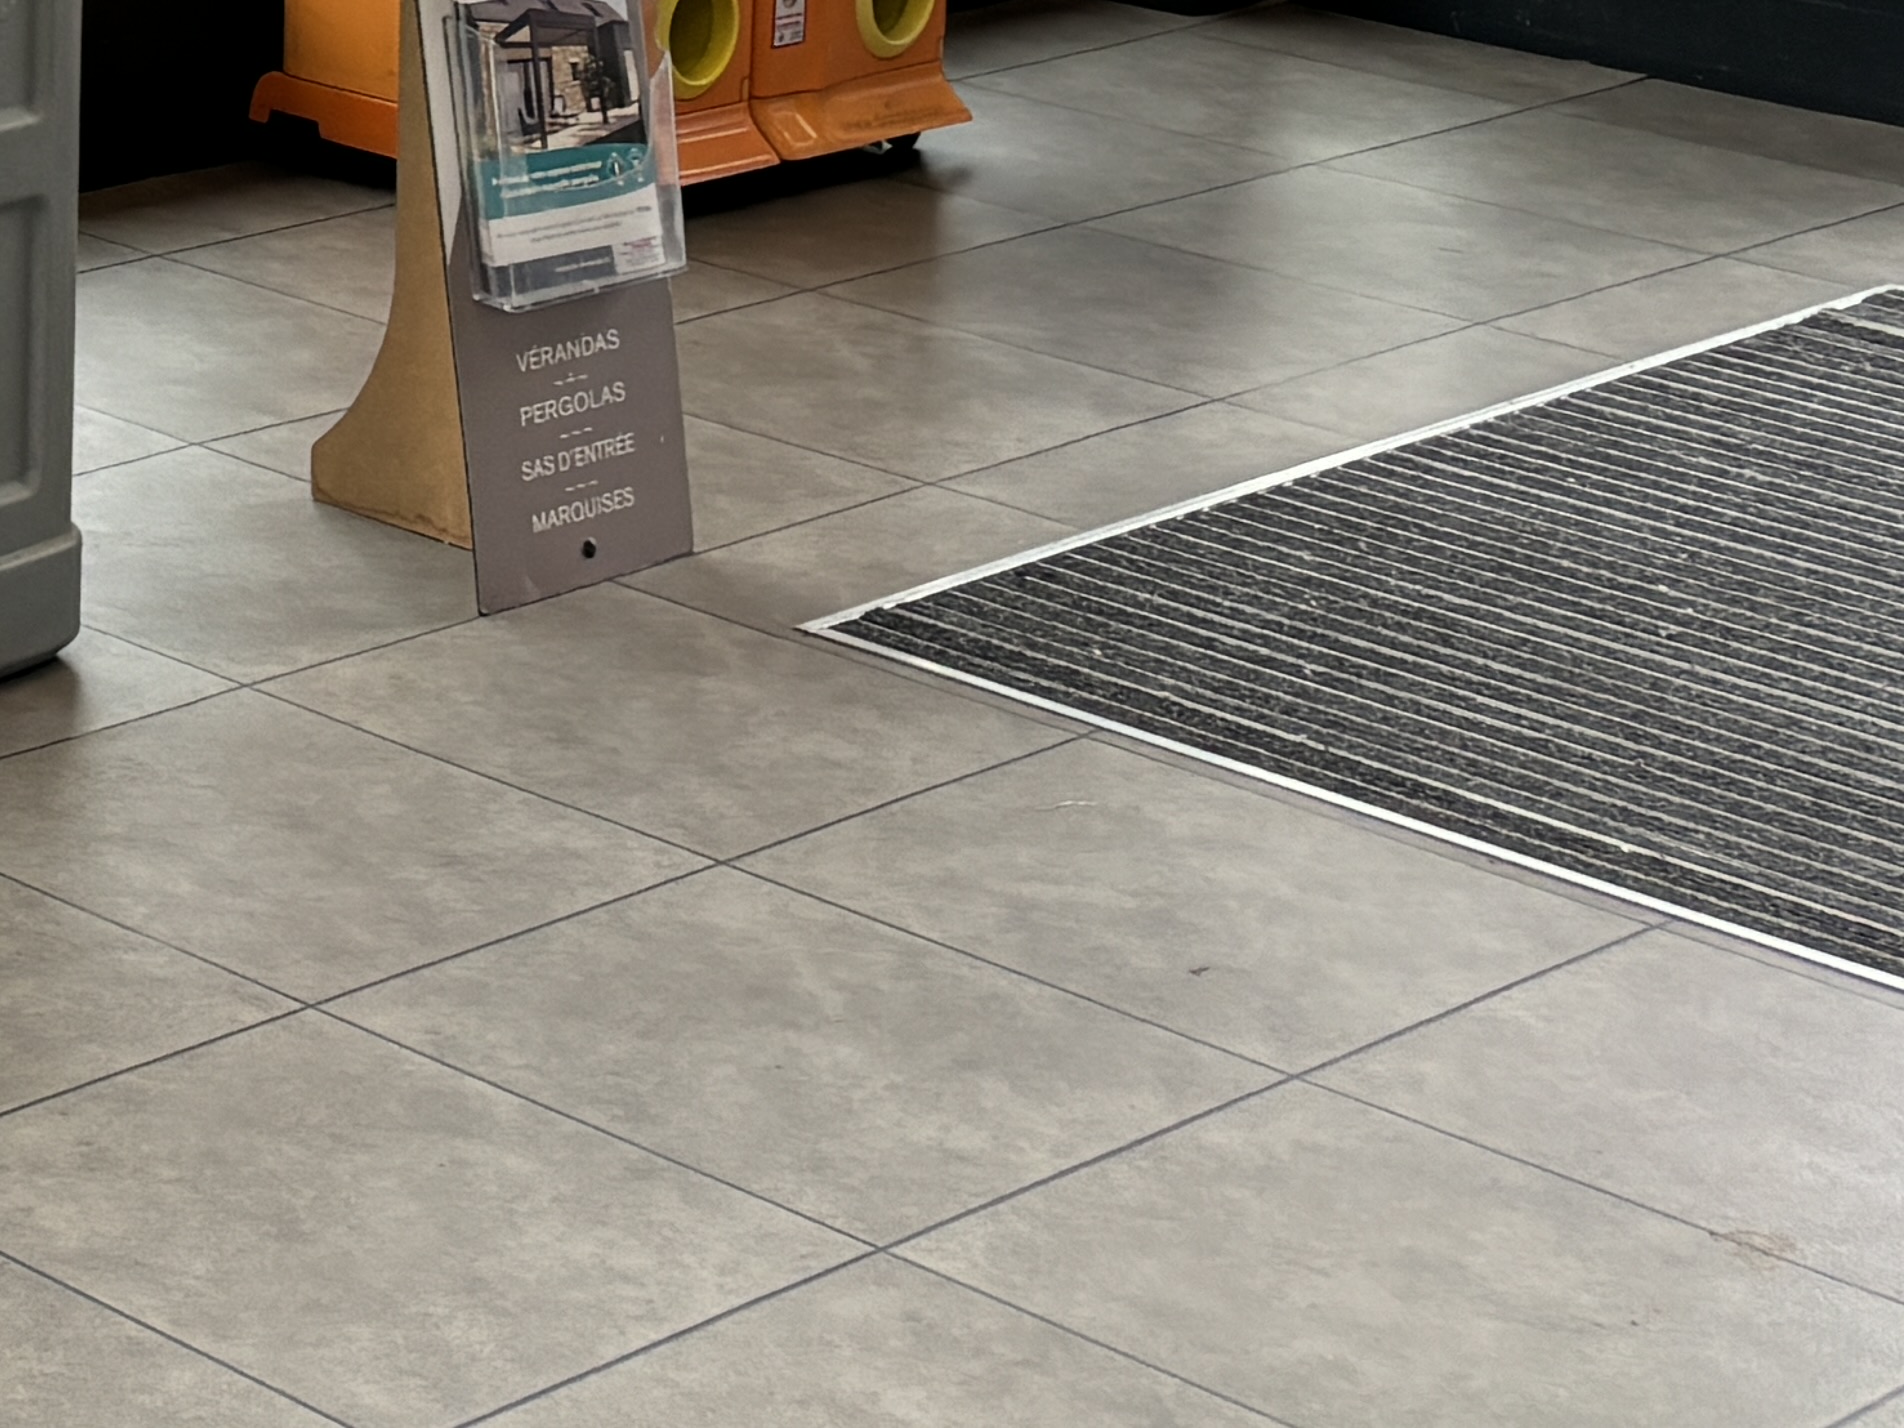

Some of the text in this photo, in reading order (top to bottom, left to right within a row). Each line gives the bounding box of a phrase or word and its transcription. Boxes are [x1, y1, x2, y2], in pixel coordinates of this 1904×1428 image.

[516, 326, 621, 374] VÉRANDAS
[519, 380, 626, 428] PERGOLAS
[521, 431, 636, 482] SAS D'ENTRÉE
[530, 485, 636, 534] MARQUISES
